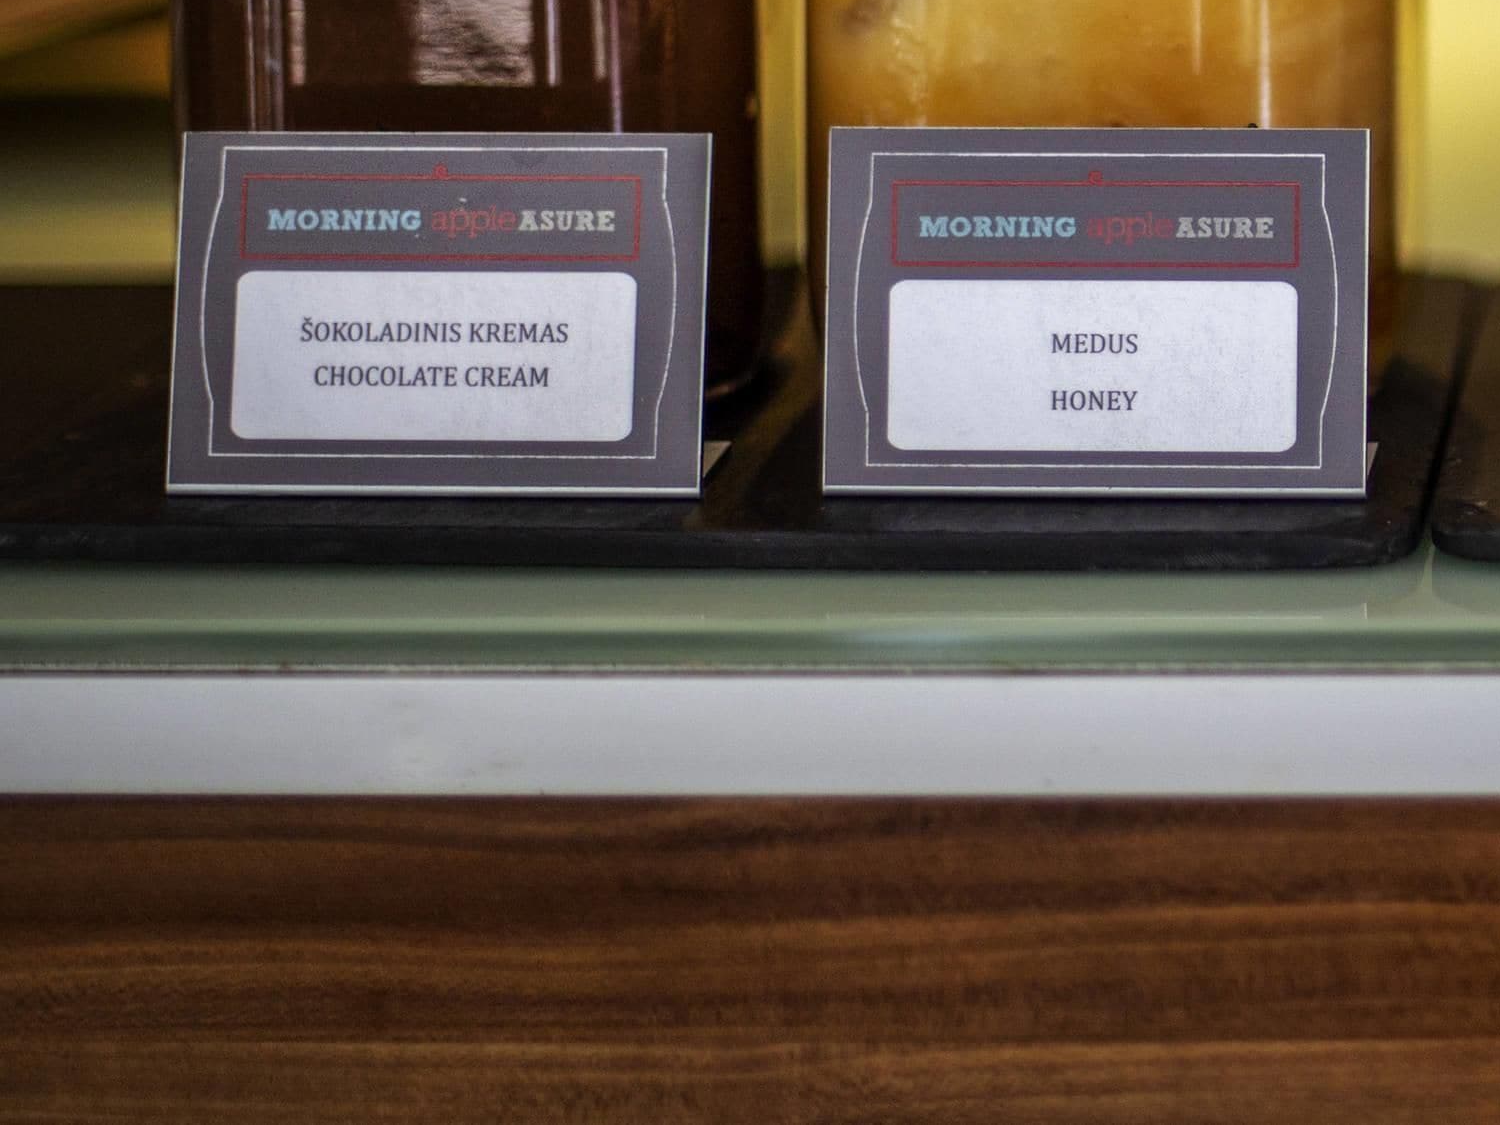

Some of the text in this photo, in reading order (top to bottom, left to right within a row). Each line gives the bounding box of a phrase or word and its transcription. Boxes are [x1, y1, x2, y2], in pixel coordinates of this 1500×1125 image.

[267, 208, 422, 233] MORNING
[919, 215, 1077, 239] MORNING
[299, 316, 570, 344] ŠOKOLADINIS KREMAS
[1051, 333, 1139, 355] MEDUS
[313, 364, 550, 388] CHOCOLATE CREAM
[1050, 390, 1139, 412] HONEY
